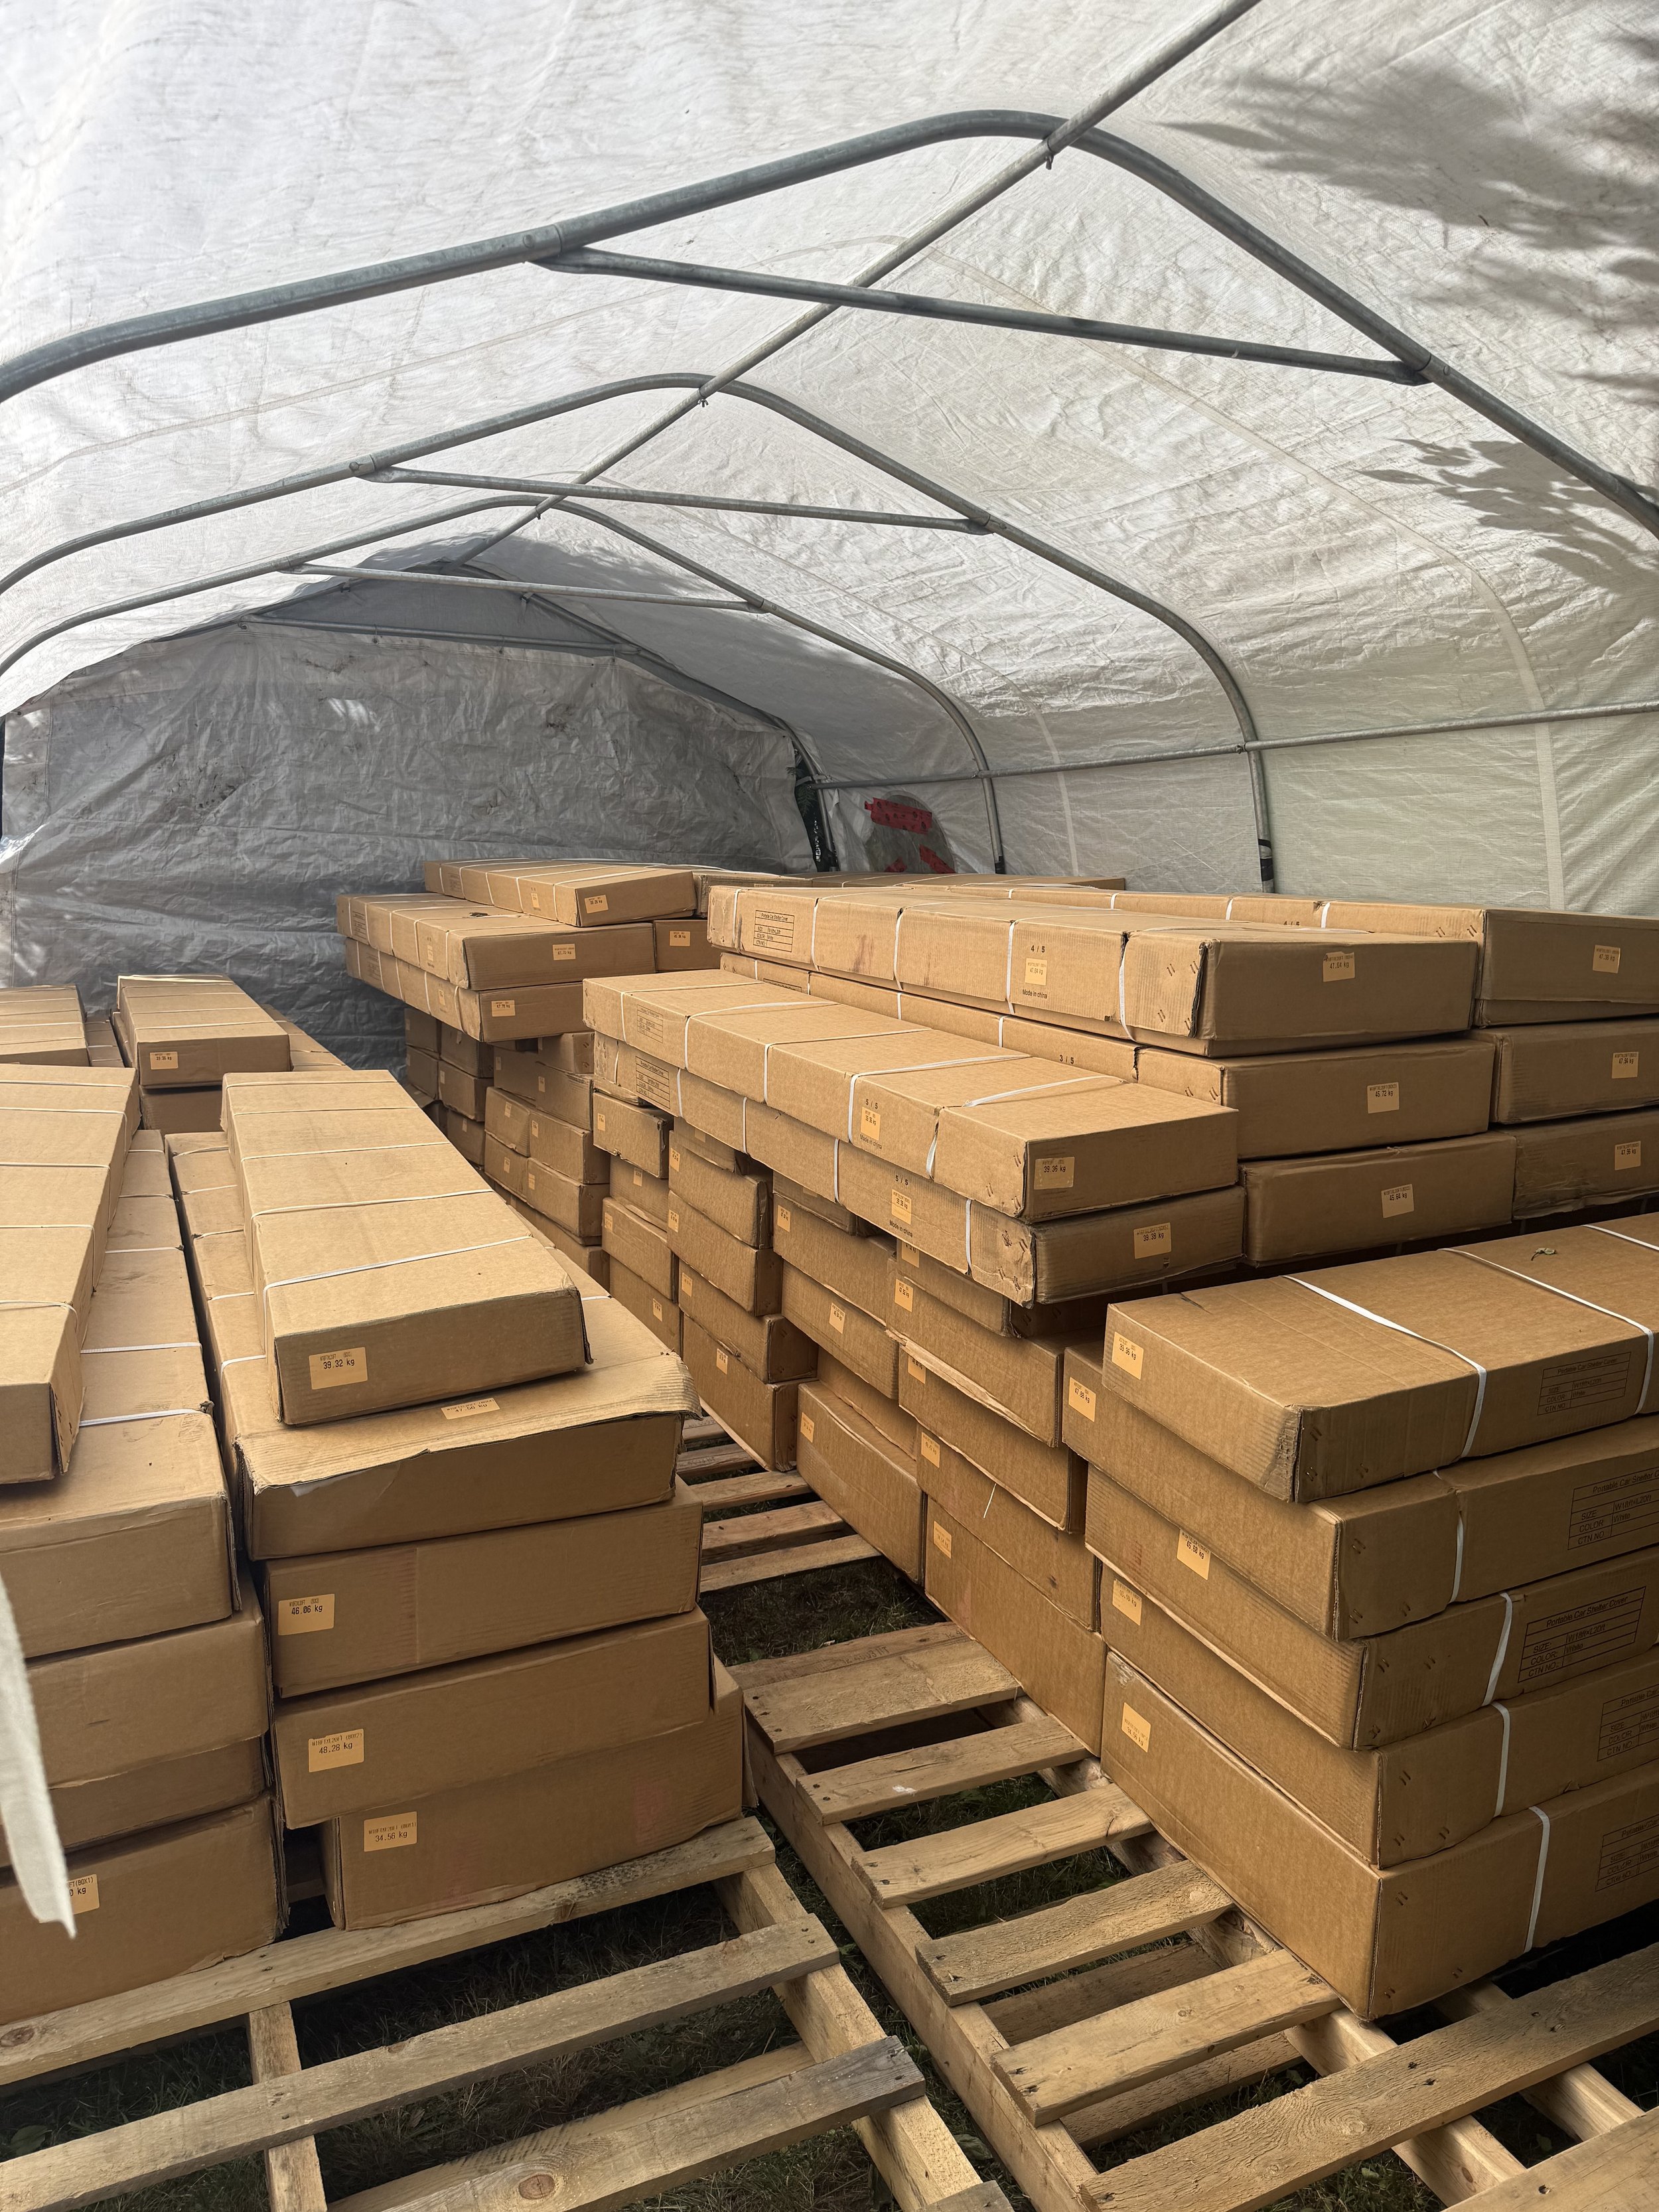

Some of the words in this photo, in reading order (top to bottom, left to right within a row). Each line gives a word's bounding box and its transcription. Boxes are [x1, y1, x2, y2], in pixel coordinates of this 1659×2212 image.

[323, 1359, 343, 1370] 39.32
[346, 1358, 356, 1367] kg
[1593, 1481, 1618, 1494] Portable
[1619, 1479, 1630, 1487] Car
[1199, 1548, 1204, 1560] kg
[292, 1606, 312, 1616] 46.06
[314, 1604, 323, 1613] kg
[1546, 1614, 1572, 1628] Portable
[1573, 1609, 1587, 1620] Car
[1587, 1602, 1609, 1616] Shelter
[1609, 1596, 1628, 1607] Cover
[319, 1743, 341, 1755] 48.28
[344, 1741, 353, 1750] kg
[376, 1832, 396, 1842] 34.56
[399, 1830, 408, 1839] kg
[78, 1887, 87, 1895] kg
